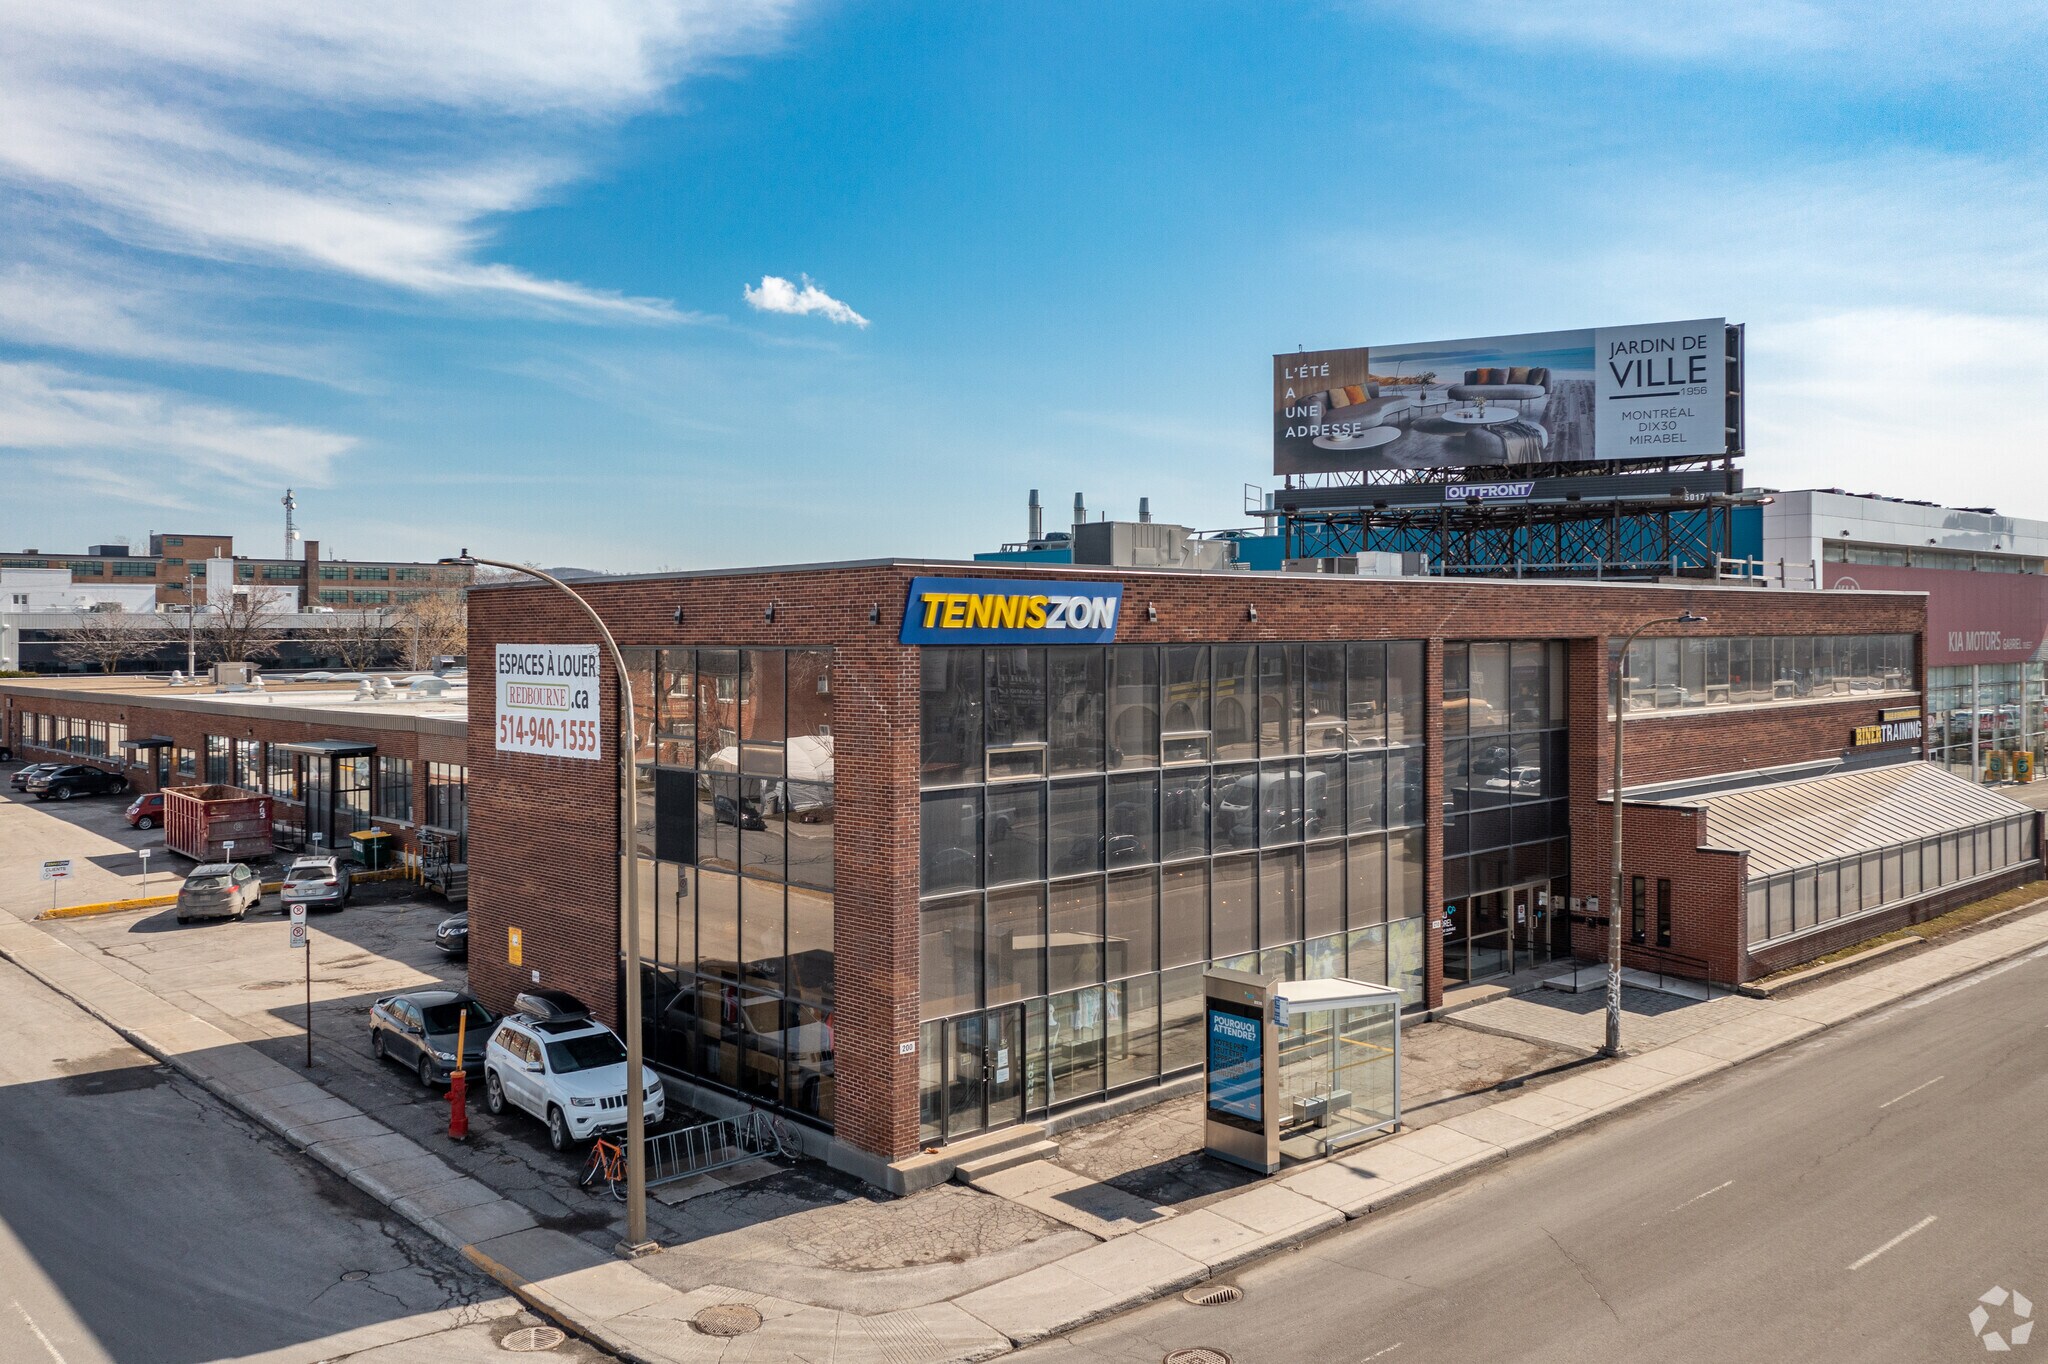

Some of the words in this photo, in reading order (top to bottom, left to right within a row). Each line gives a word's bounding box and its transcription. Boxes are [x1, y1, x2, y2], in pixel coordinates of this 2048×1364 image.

[1609, 337, 1675, 360] JARDIN
[1682, 335, 1707, 351] DE
[1285, 362, 1330, 379] L'ÉTÉ
[1609, 355, 1707, 389] VILLE
[1285, 387, 1296, 399] A
[1680, 386, 1708, 396] 1956
[1285, 405, 1319, 418] UNE
[1621, 407, 1695, 421] MONTRÉAL
[1285, 422, 1362, 438] ADRESSE
[1638, 421, 1677, 432] DIX30
[1629, 433, 1687, 445] MIRABEL
[1448, 484, 1530, 498] OUTFRONT
[920, 592, 1118, 629] TENNISZON
[1948, 631, 1964, 652] KIA
[1965, 631, 2001, 651] MOTORS
[499, 653, 545, 676] ESPACES
[546, 650, 555, 676] À
[557, 654, 597, 678] LOUER
[509, 686, 567, 707] REDBOURNE
[499, 714, 597, 752] 514-940-1555
[1213, 1015, 1255, 1033] POURQUOI
[1213, 1024, 1257, 1042] ATTENDRE?
[902, 1043, 914, 1053] 200
[1027, 1062, 1035, 1105] HOMME
